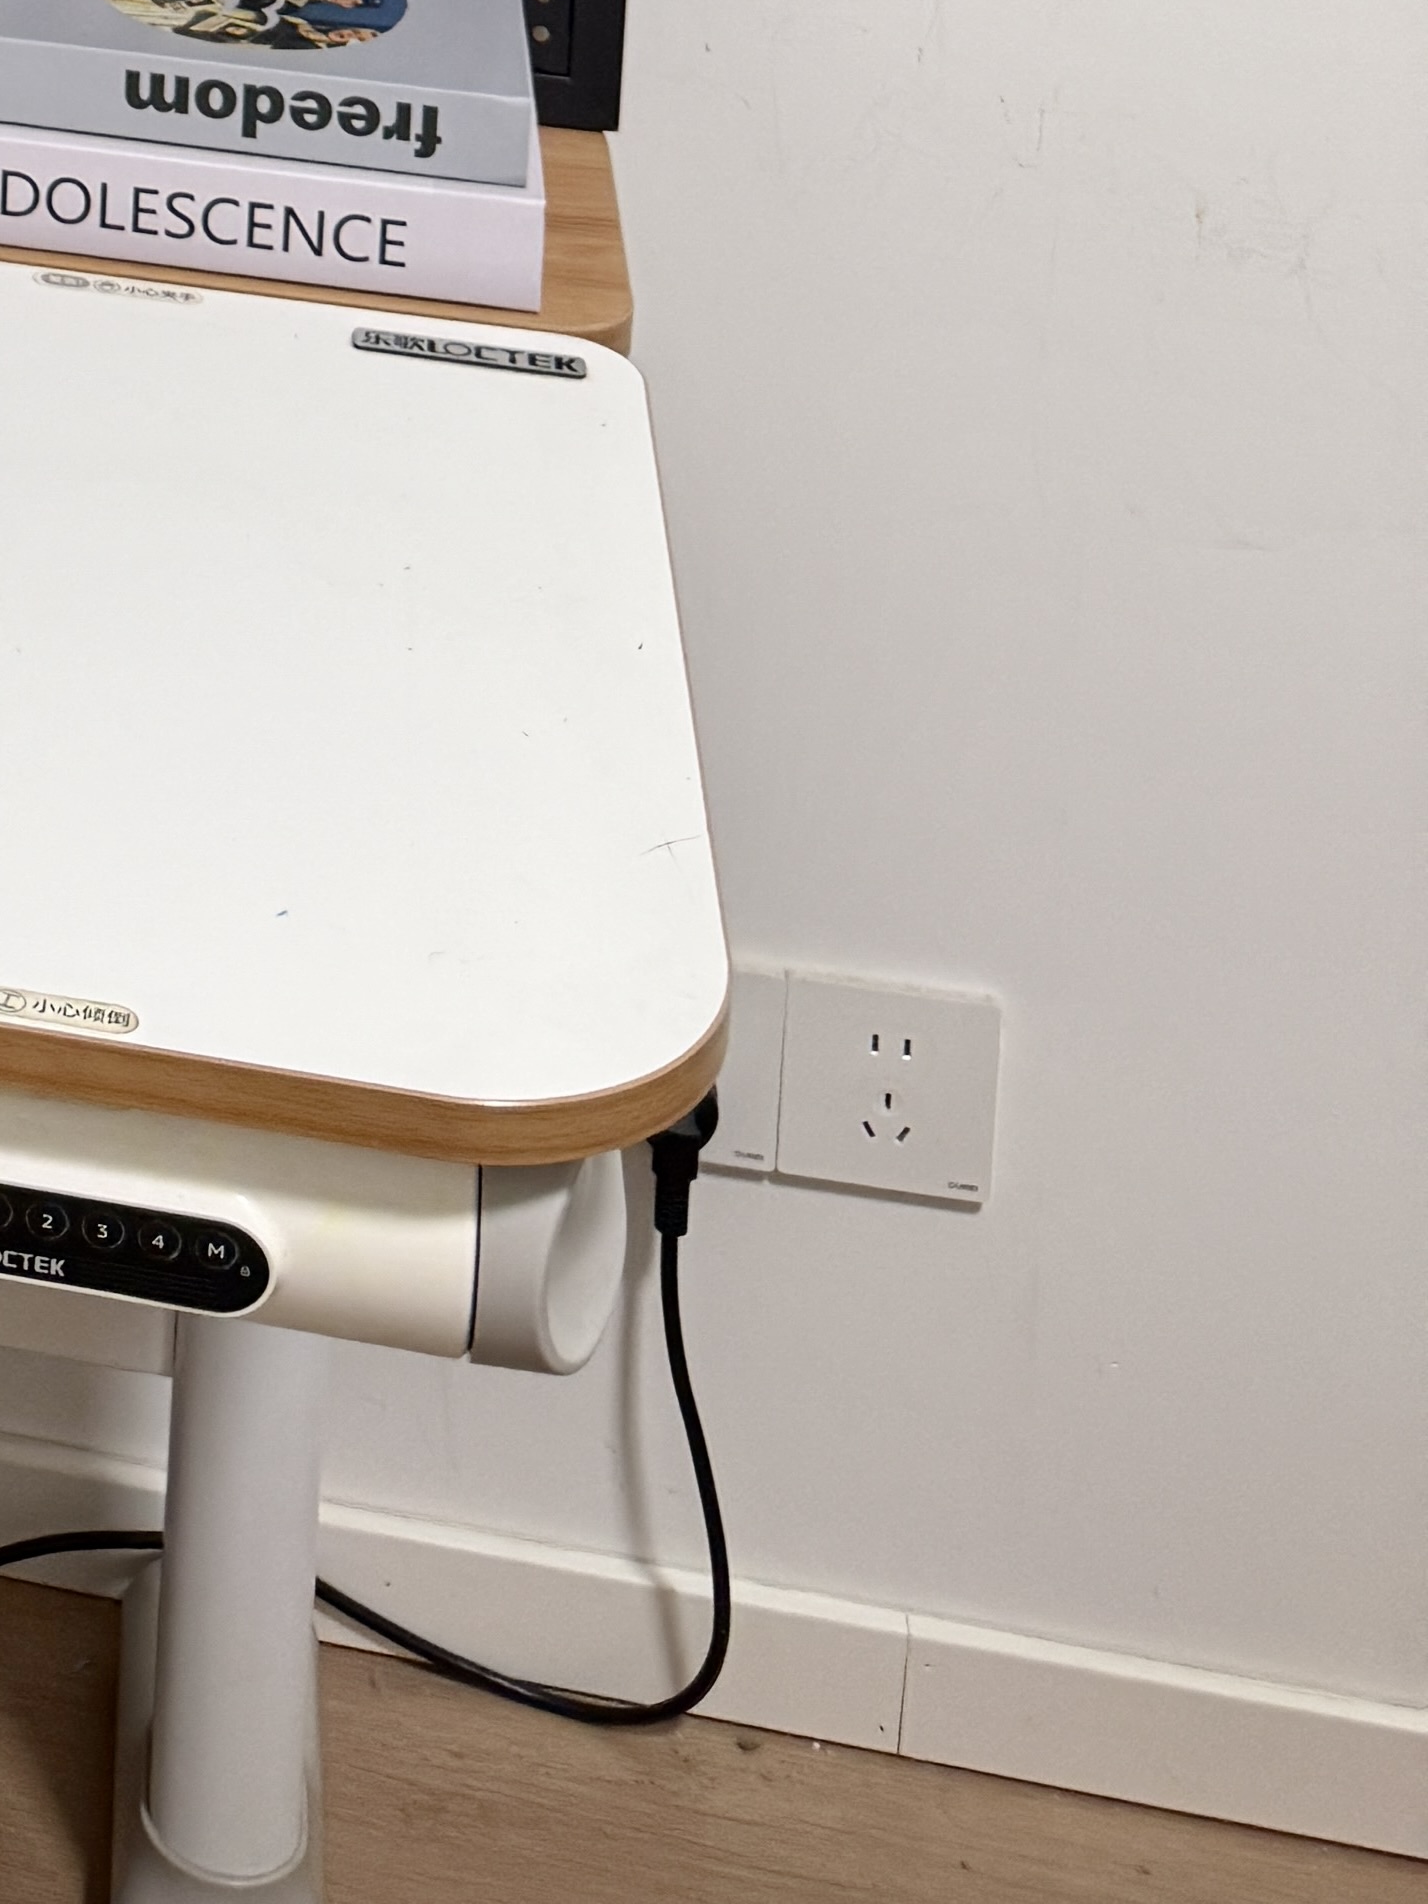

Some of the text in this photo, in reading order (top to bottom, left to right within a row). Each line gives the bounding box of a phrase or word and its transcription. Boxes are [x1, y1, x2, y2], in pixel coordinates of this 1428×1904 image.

[124, 68, 443, 159] freedom
[32, 999, 132, 1027] 小心倾倒
[42, 1214, 53, 1230] 2
[97, 1223, 108, 1239] 3
[152, 1235, 164, 1250] 4
[208, 1243, 225, 1260] M
